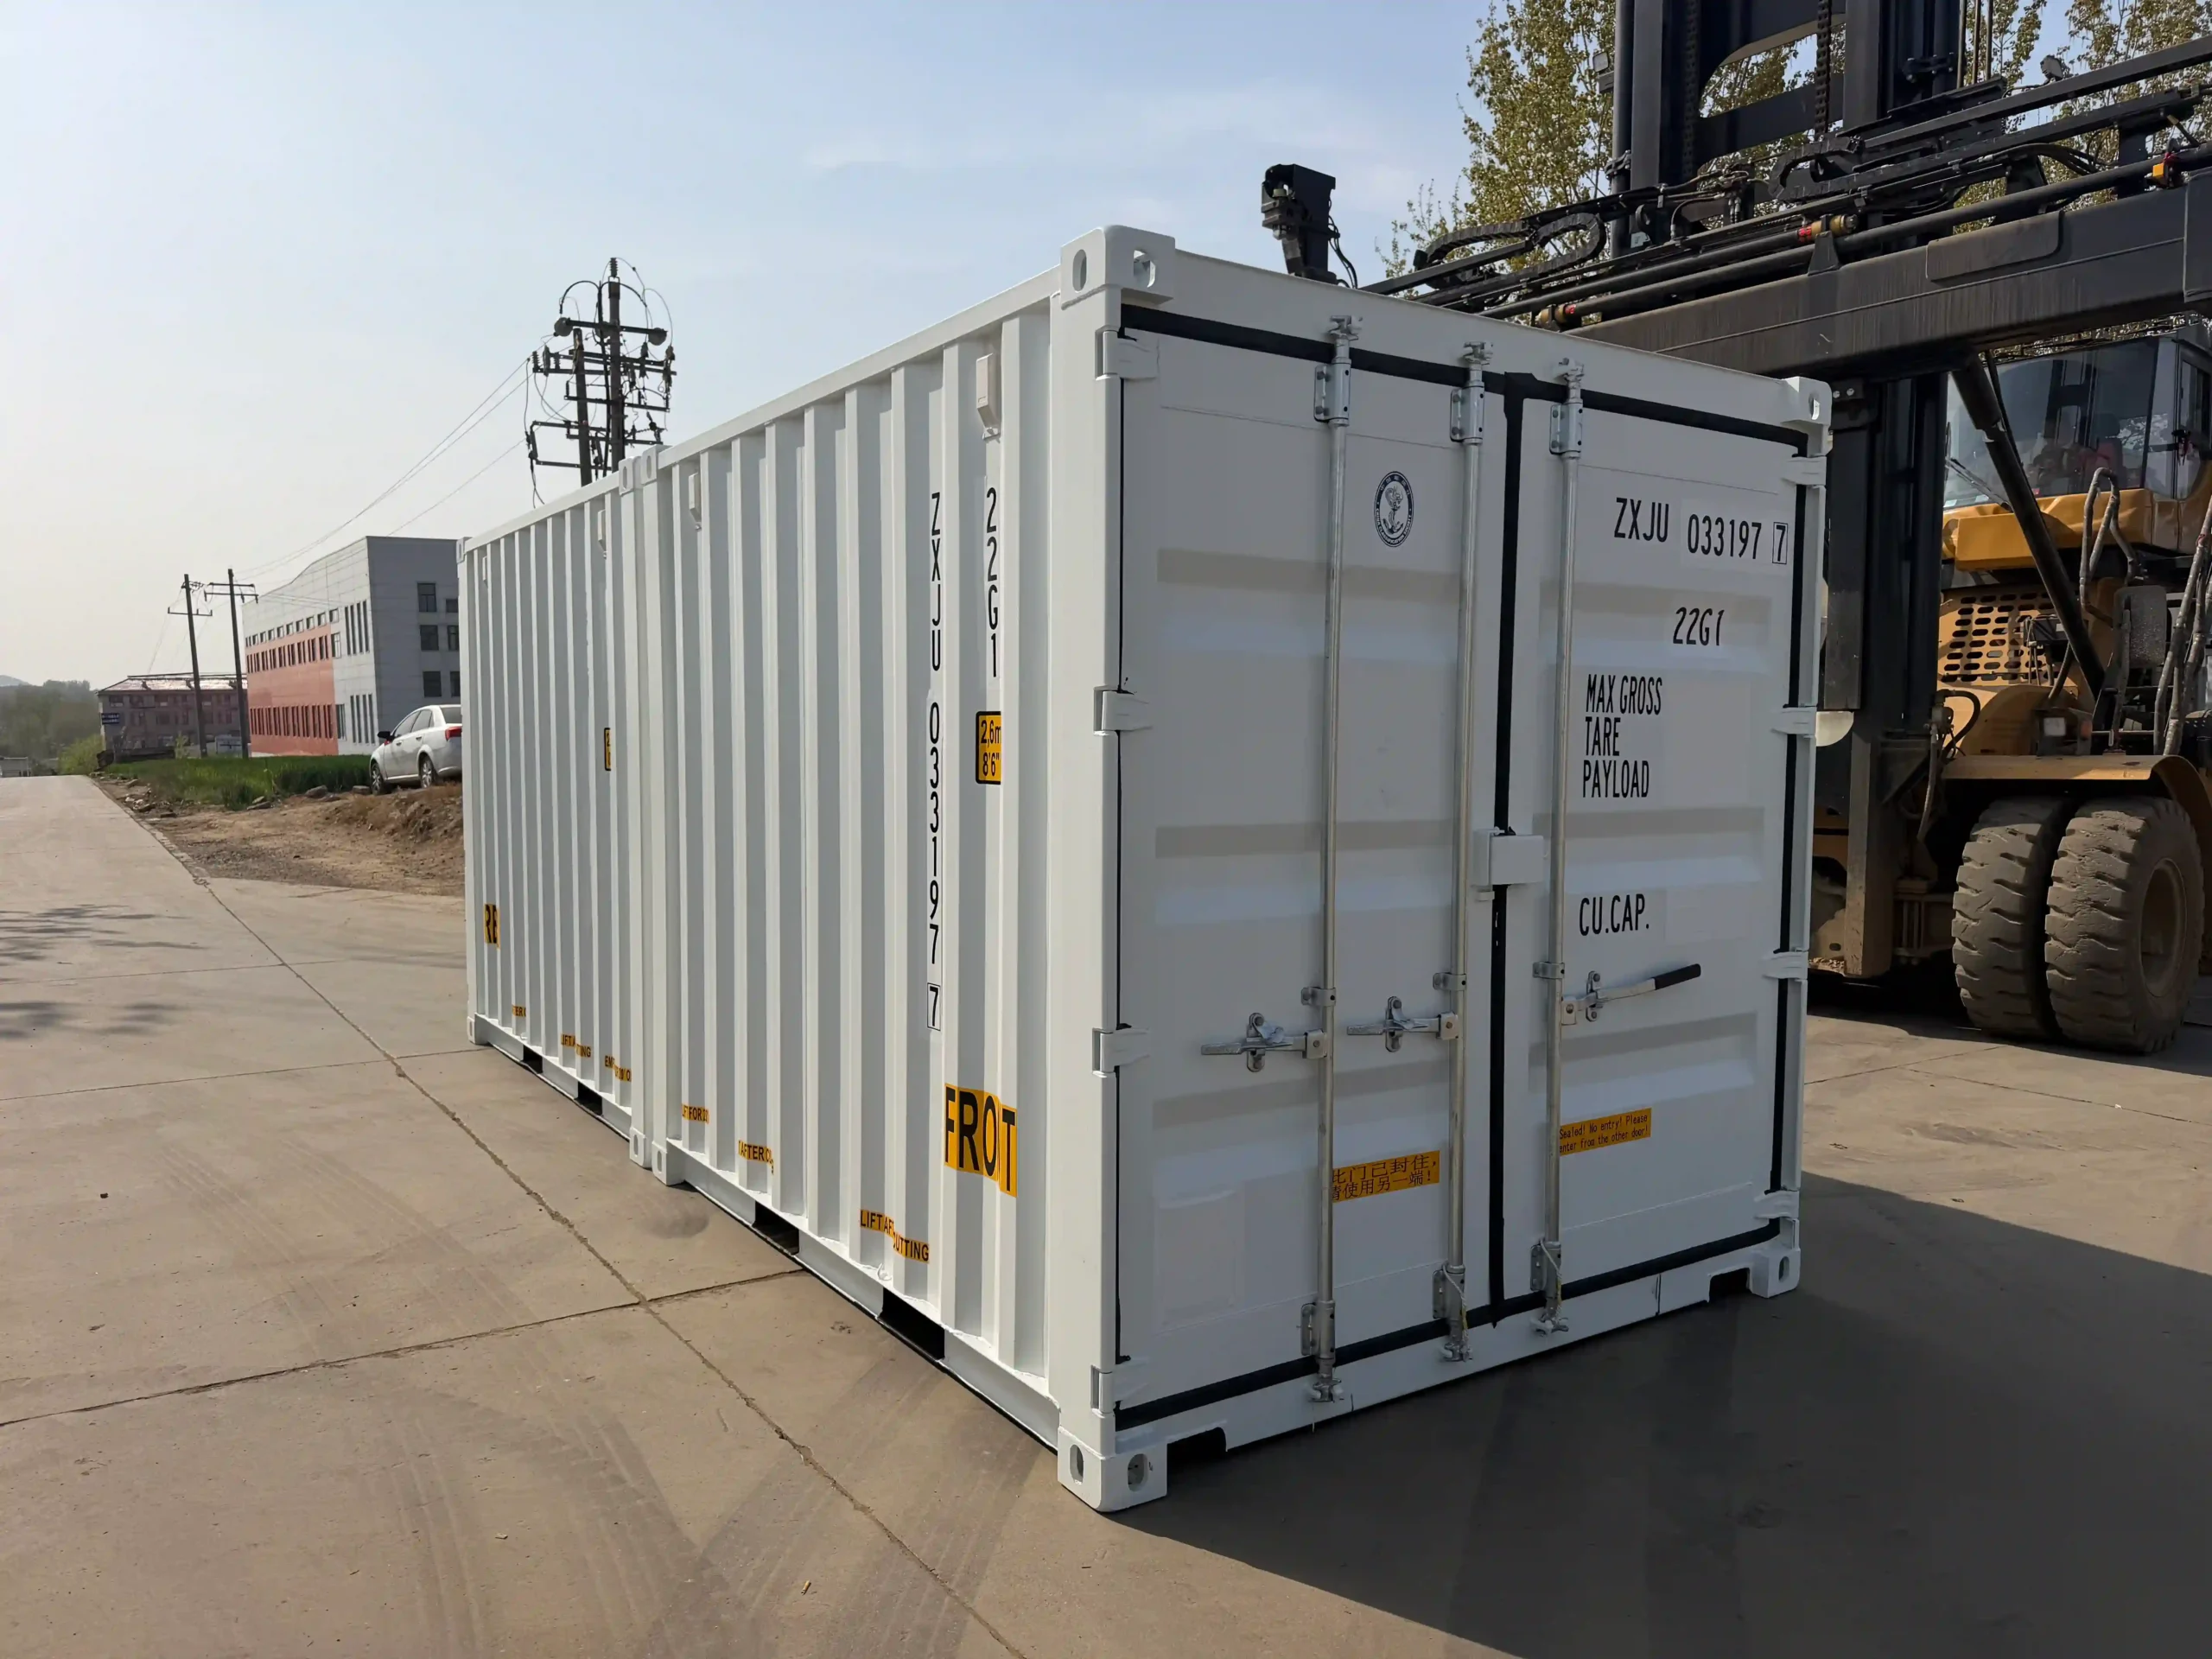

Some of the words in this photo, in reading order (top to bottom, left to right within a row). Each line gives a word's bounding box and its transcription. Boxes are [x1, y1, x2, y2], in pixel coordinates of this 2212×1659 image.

[1613, 497, 1669, 543] ZXJU
[1688, 513, 1762, 560] 033197
[1776, 524, 1786, 563] 7
[931, 492, 941, 671] ZXJU
[986, 486, 998, 677] 22G1
[1673, 607, 1725, 646] 22G1
[1586, 673, 1616, 714] MAX
[1619, 675, 1662, 715] GROSS
[1585, 715, 1621, 757] TARE
[1582, 760, 1649, 798] PAYLOAD
[929, 702, 940, 964] 033197
[1580, 893, 1649, 937] CU.CAP.
[929, 986, 938, 1027] 7
[1559, 1122, 1586, 1140] Sealed!
[1589, 1122, 1598, 1133] No
[1600, 1117, 1623, 1130] entry!
[1625, 1113, 1648, 1126] Please
[1559, 1142, 1577, 1154] enter
[1580, 1137, 1595, 1149] from
[1598, 1135, 1609, 1145] the
[1611, 1130, 1629, 1141] other
[1631, 1124, 1648, 1138] door!
[860, 1210, 882, 1231] LIFT
